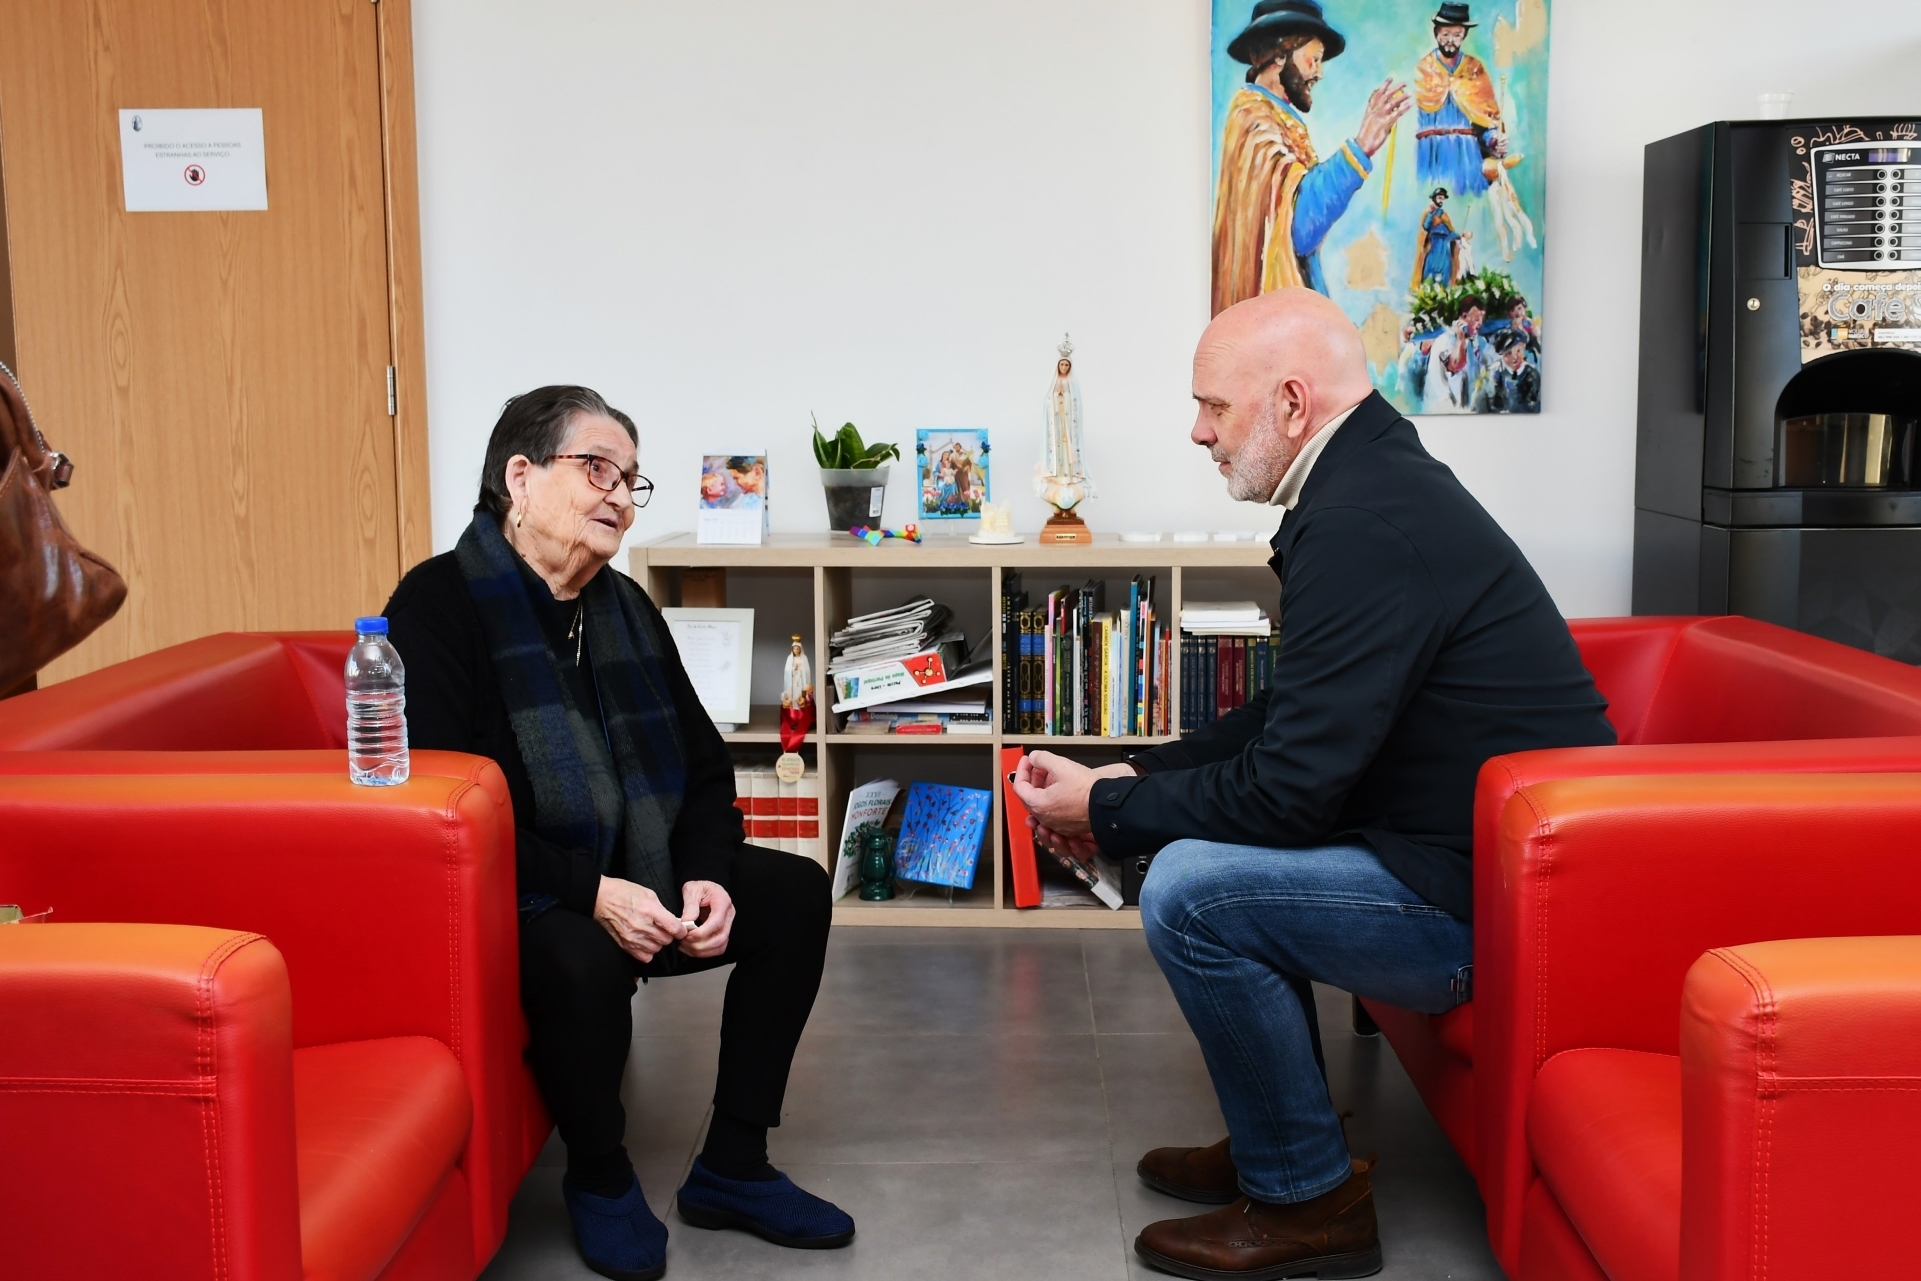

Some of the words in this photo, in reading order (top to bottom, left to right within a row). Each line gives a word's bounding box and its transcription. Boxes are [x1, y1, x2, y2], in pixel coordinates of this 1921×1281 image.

[1835, 153, 1860, 161] NECTA
[1834, 282, 1851, 291] dia
[1853, 283, 1893, 293] começa
[870, 712, 898, 720] Domino
[868, 798, 892, 806] FLORAIS
[850, 808, 888, 820] MONFORTE
